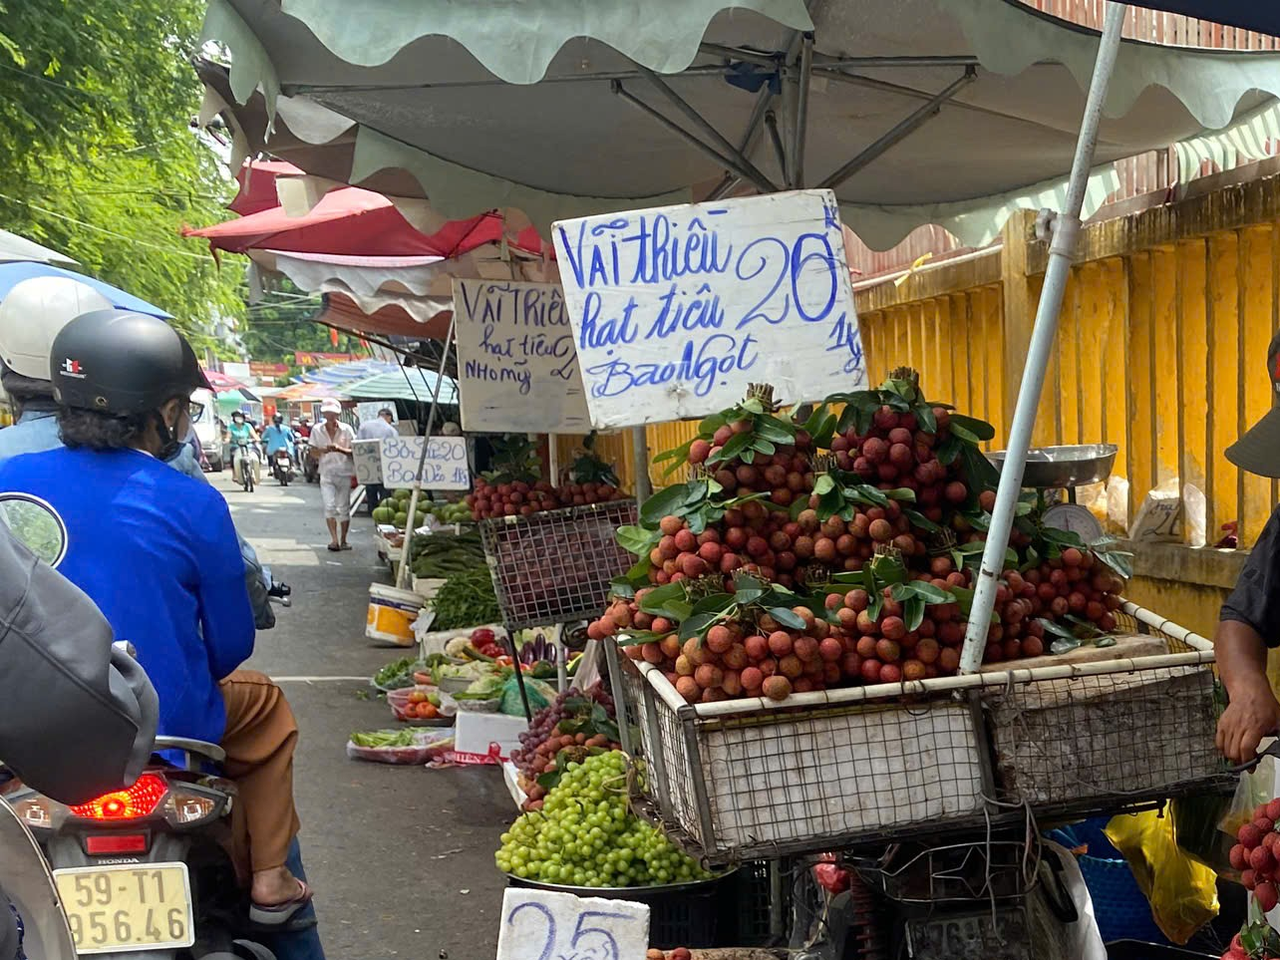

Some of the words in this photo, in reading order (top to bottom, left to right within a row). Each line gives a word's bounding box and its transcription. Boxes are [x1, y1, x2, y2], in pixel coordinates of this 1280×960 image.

[644, 283, 724, 340] tiêu
[97, 857, 140, 865] HONDA
[74, 870, 166, 908] 59-T1
